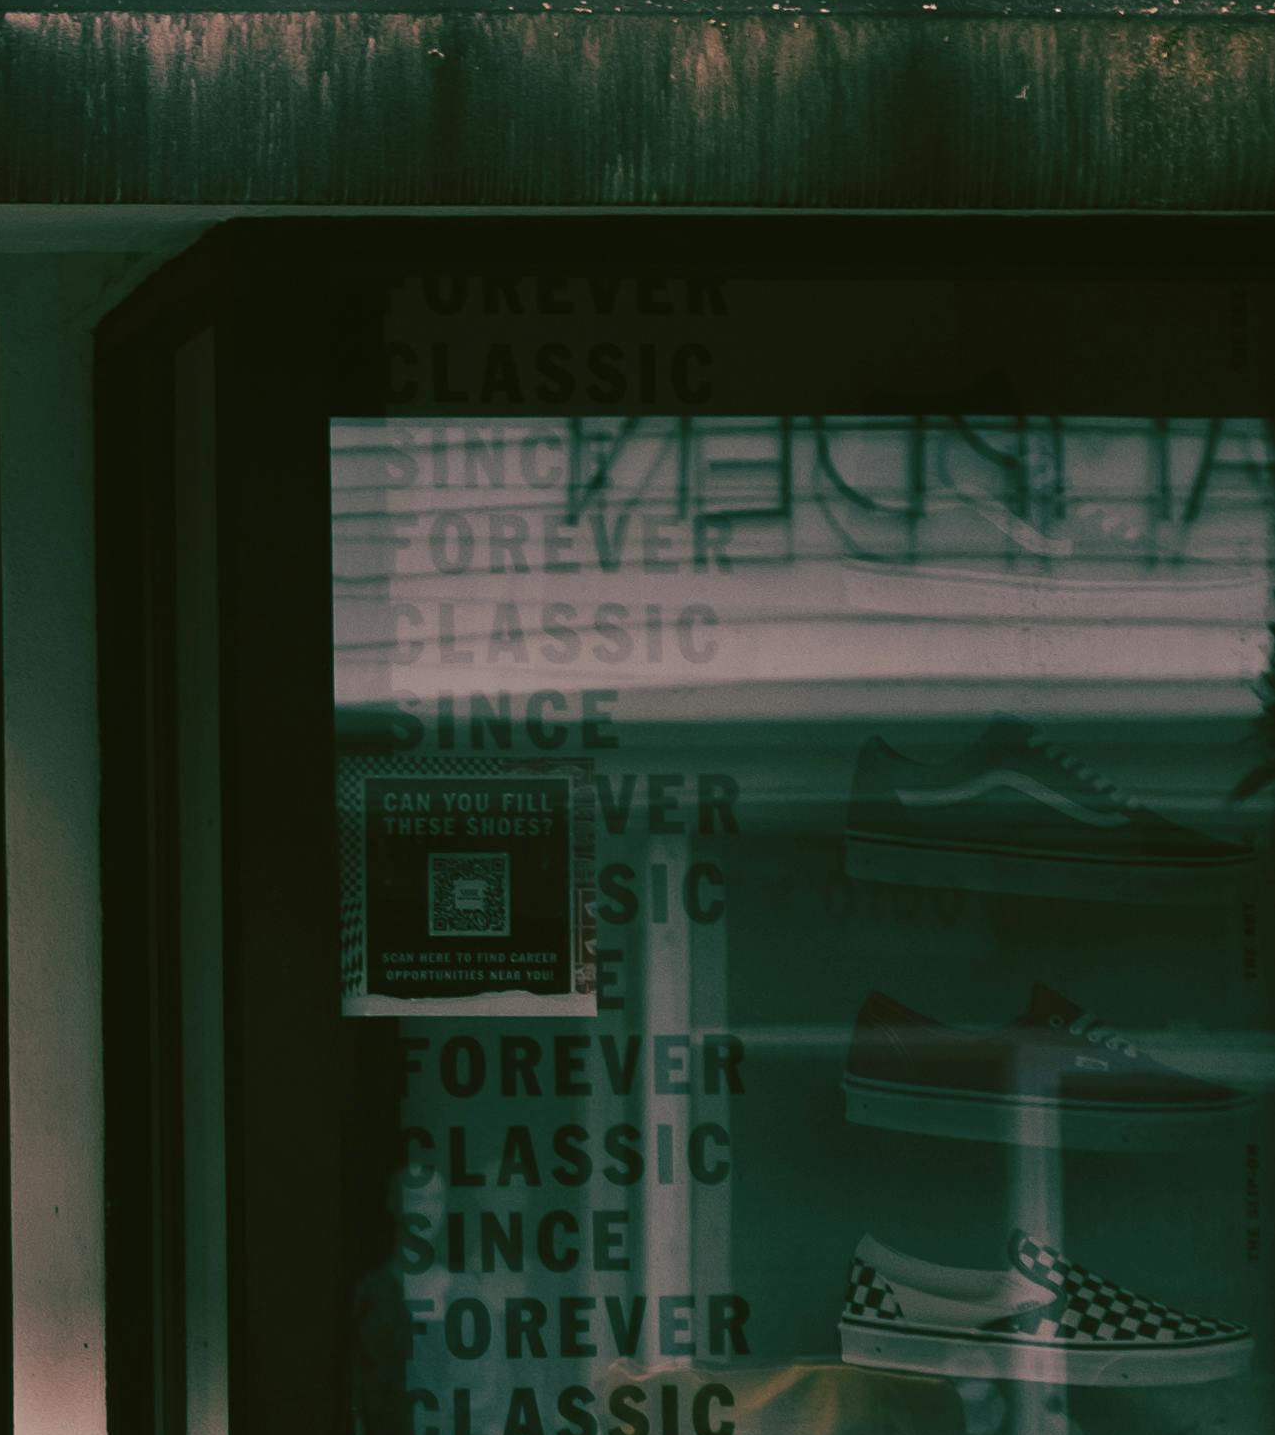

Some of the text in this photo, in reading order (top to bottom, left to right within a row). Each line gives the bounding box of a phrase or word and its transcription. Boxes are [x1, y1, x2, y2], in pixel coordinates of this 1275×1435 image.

[384, 342, 715, 405] CLASSIC
[390, 602, 721, 665] CLASSIC
[391, 690, 621, 752] SINCE
[382, 792, 554, 813] CAN YOU FILL
[382, 816, 554, 837] THESE SHOES?
[381, 952, 558, 964] SCAN HERE TO FIND CAREER
[385, 970, 485, 982] OPPORTUNITIES
[489, 970, 522, 982] NEAR
[400, 1122, 732, 1190] CLASSIC
[401, 1210, 631, 1274] SINCE
